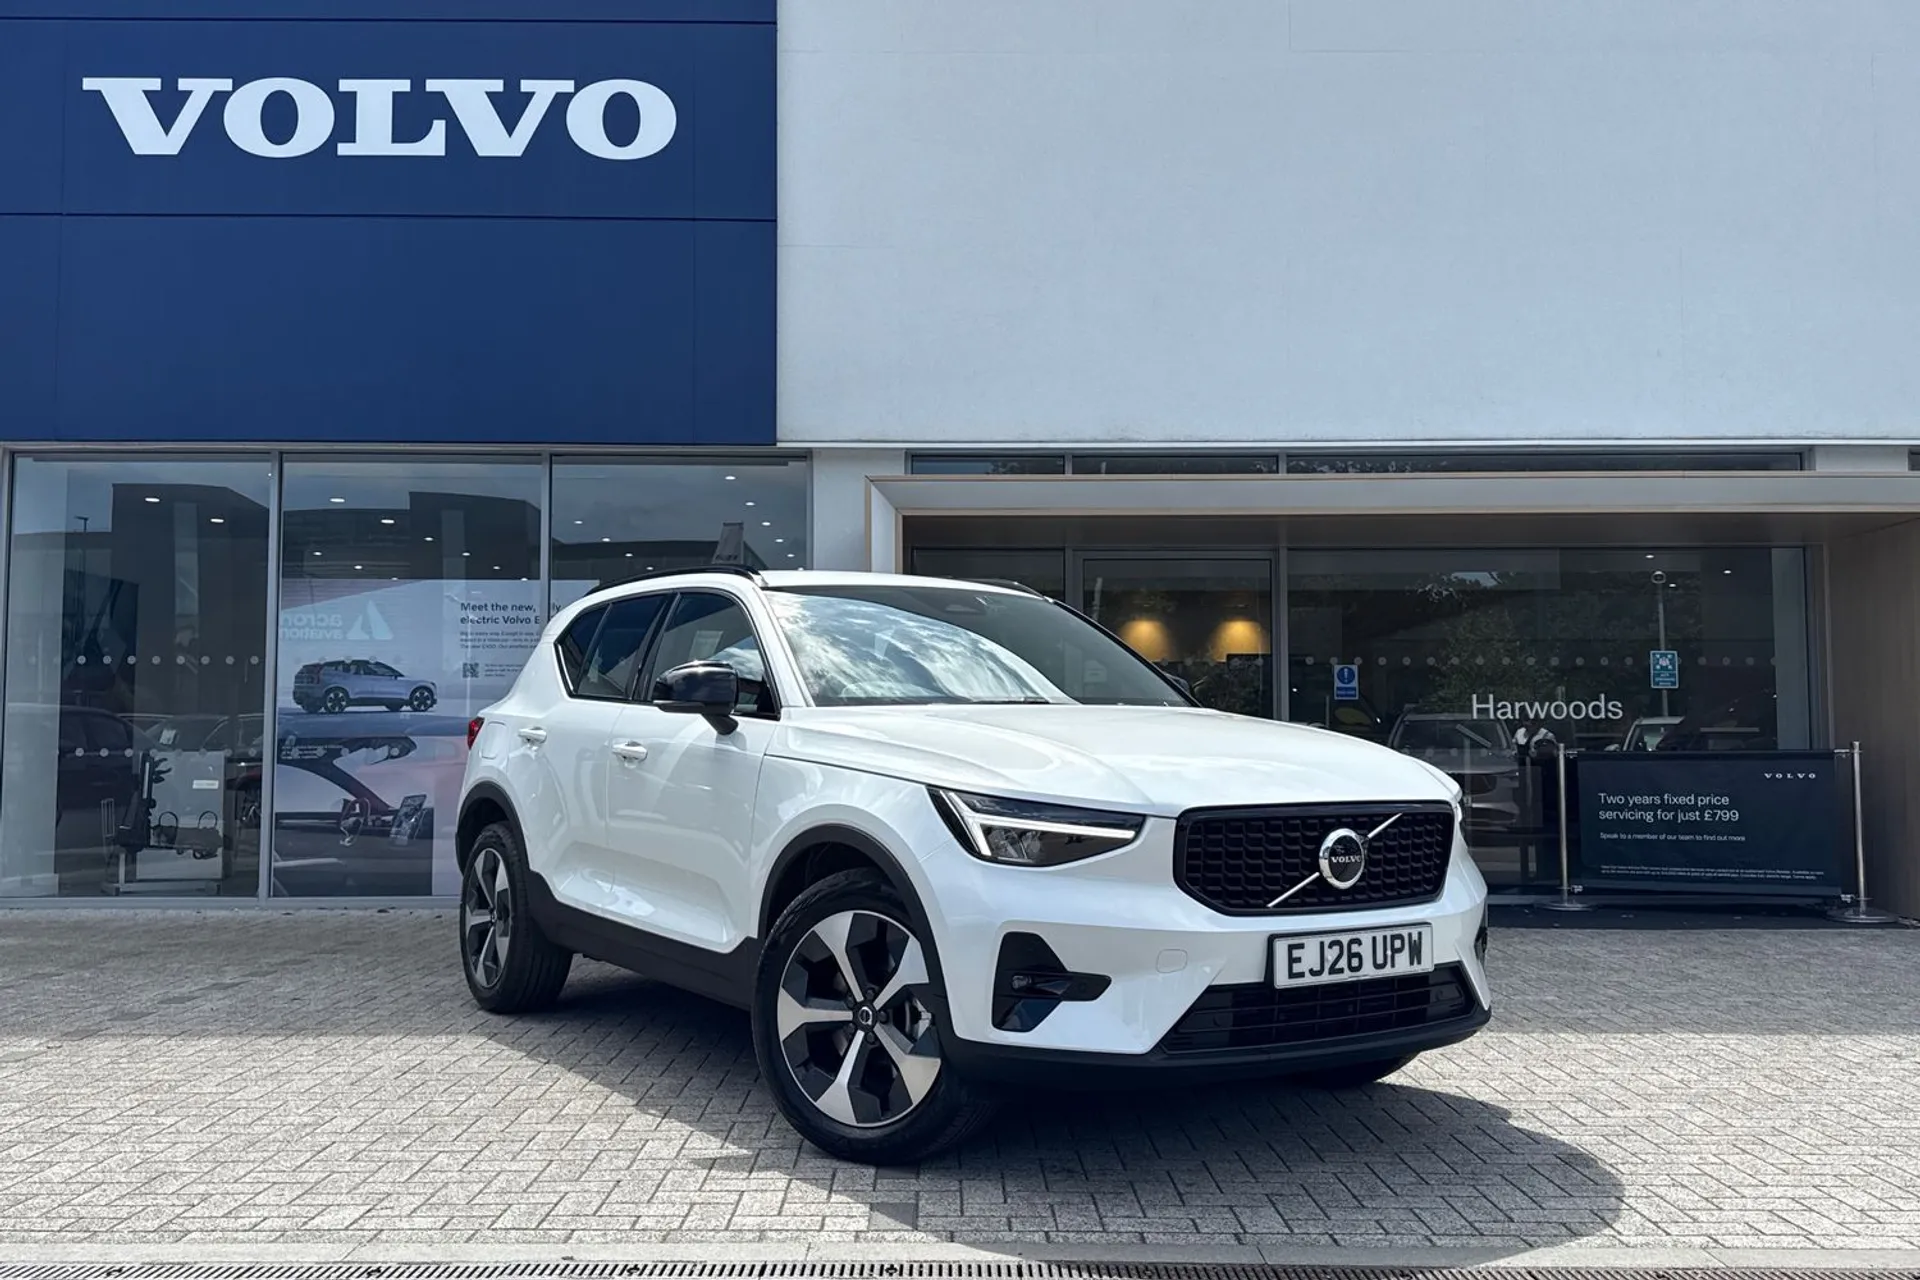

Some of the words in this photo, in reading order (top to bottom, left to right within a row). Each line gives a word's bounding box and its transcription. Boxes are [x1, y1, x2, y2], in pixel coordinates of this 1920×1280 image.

[82, 77, 677, 160] VOLVO
[461, 603, 488, 612] Meet
[491, 603, 508, 612] the
[511, 603, 536, 613] new,
[460, 615, 500, 625] electric
[503, 615, 531, 625] Volvo
[1472, 693, 1623, 720] Harwoods
[1598, 793, 1625, 804] Two
[1627, 795, 1661, 807] years
[1663, 793, 1695, 805] fixed
[1698, 794, 1730, 807] price
[1598, 809, 1654, 823] servicing
[1657, 809, 1675, 820] for
[1677, 809, 1701, 823] just
[1704, 810, 1740, 822] £799
[1600, 832, 1618, 840] Speak
[1331, 855, 1362, 863] VOLVO
[1288, 938, 1363, 979] EJ26
[1372, 931, 1422, 970] UPW
